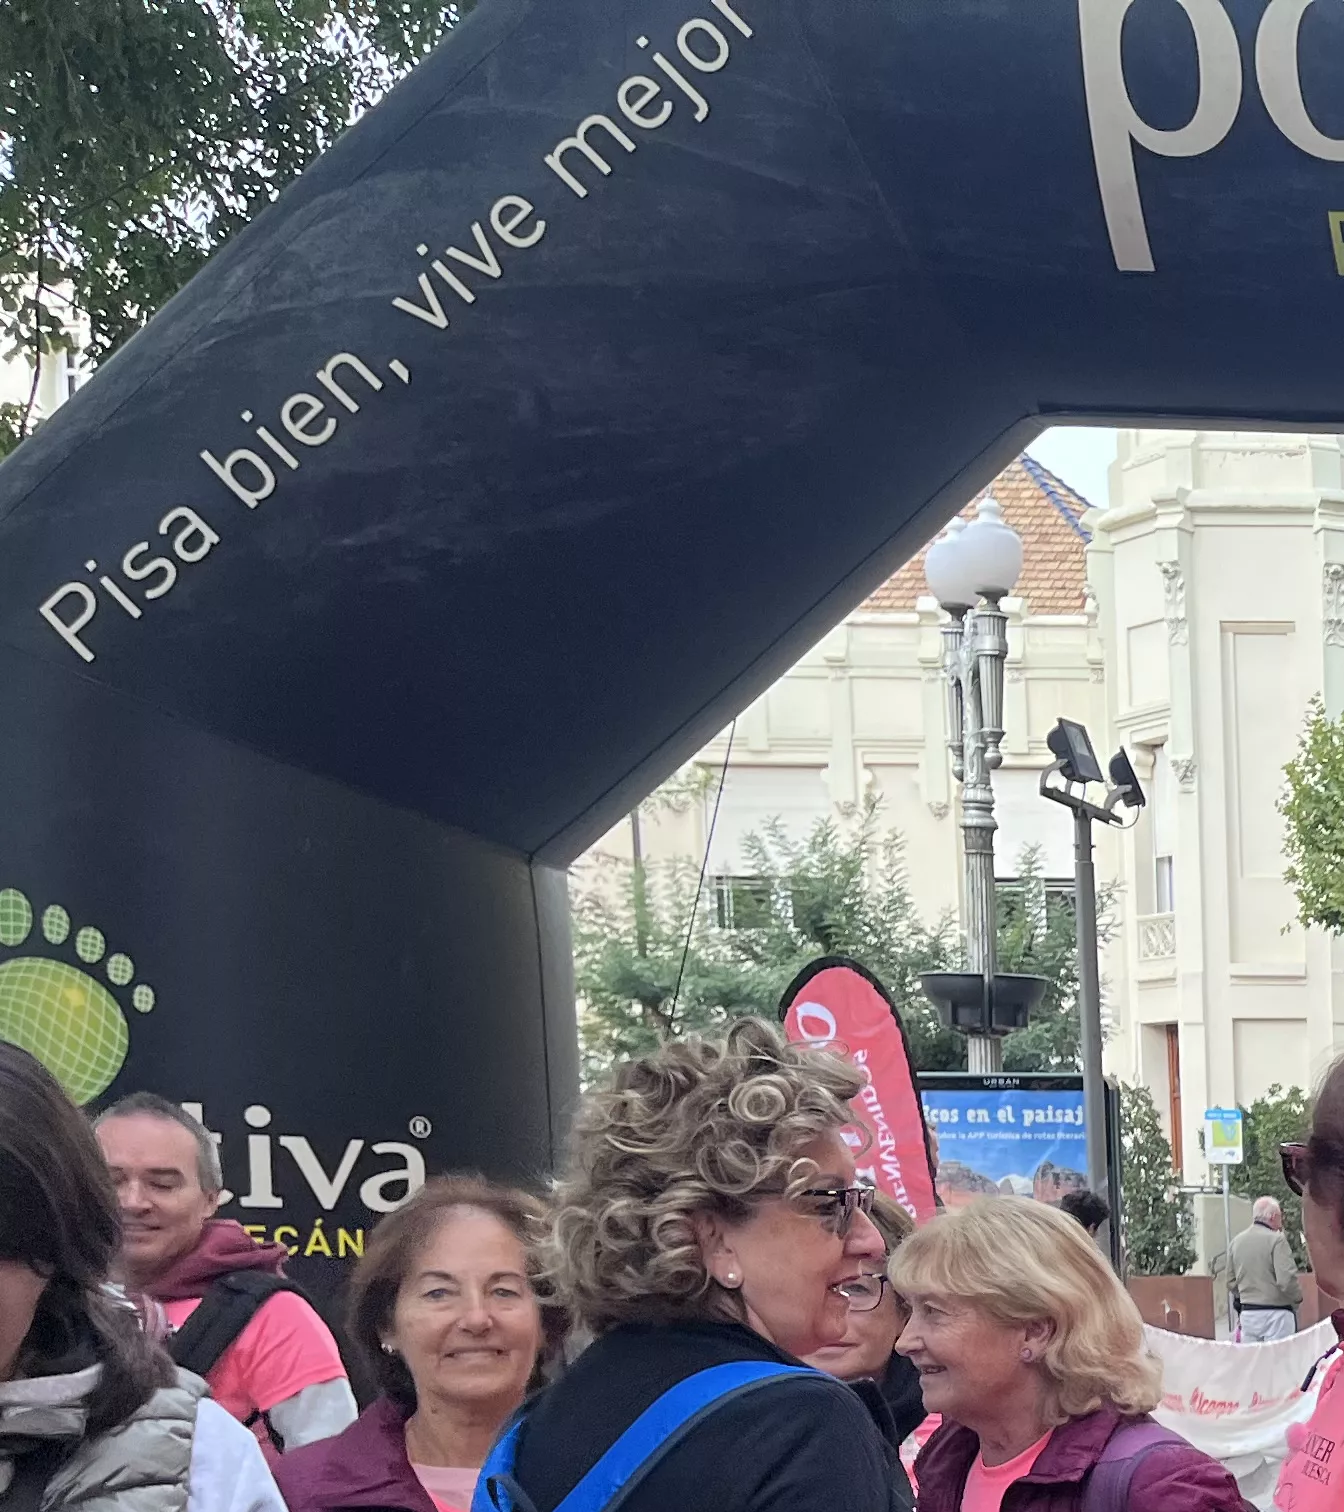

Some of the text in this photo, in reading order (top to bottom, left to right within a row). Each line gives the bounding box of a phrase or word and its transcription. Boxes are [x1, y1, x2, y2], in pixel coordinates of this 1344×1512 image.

[38, 504, 220, 663] Pisa
[200, 348, 411, 509] bien,
[391, 194, 546, 332] vive
[966, 1108, 991, 1124] en
[996, 1104, 1016, 1124] el
